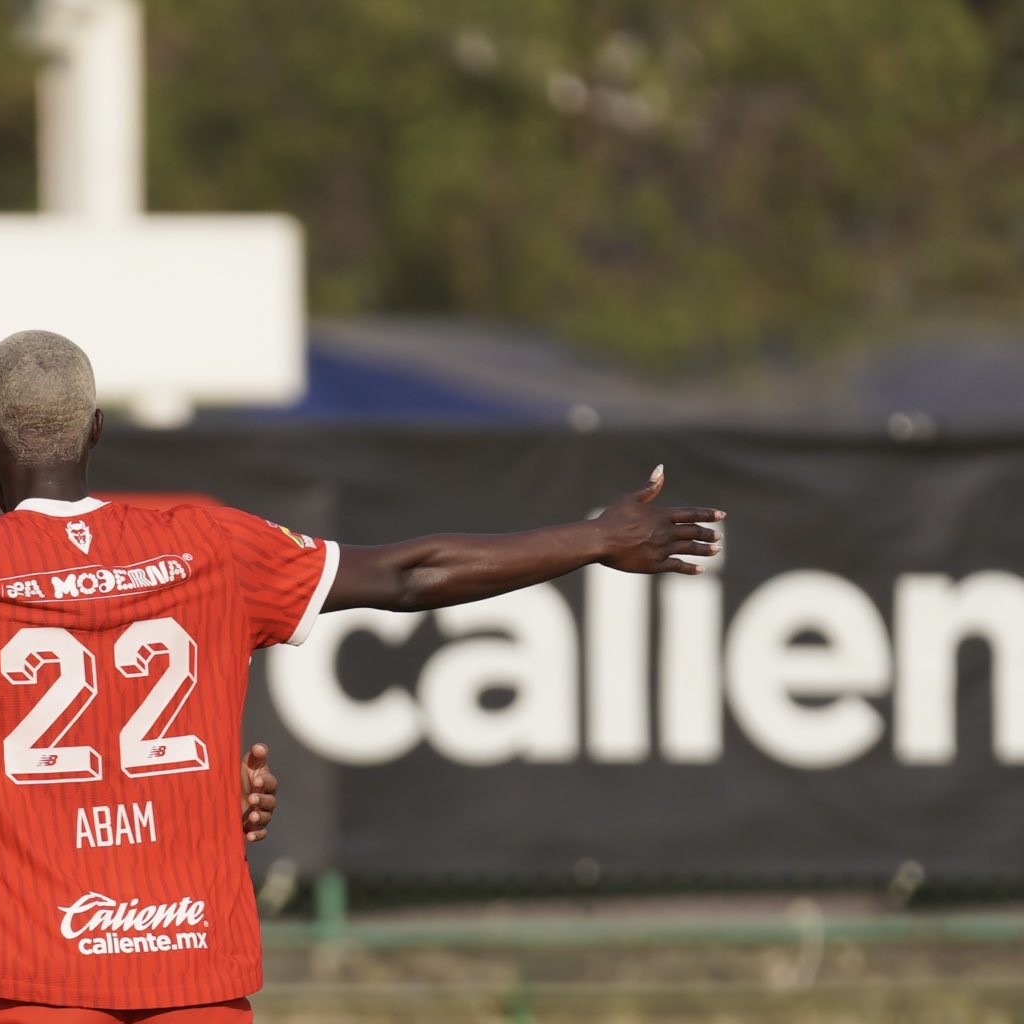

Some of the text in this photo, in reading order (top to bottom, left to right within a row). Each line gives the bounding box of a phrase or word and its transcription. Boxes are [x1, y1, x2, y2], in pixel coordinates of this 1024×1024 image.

[50, 560, 187, 599] MODERNA
[0, 616, 212, 786] 22
[75, 800, 157, 849] ABAM
[57, 890, 206, 940] Caliente
[78, 932, 209, 956] caliente.mx
